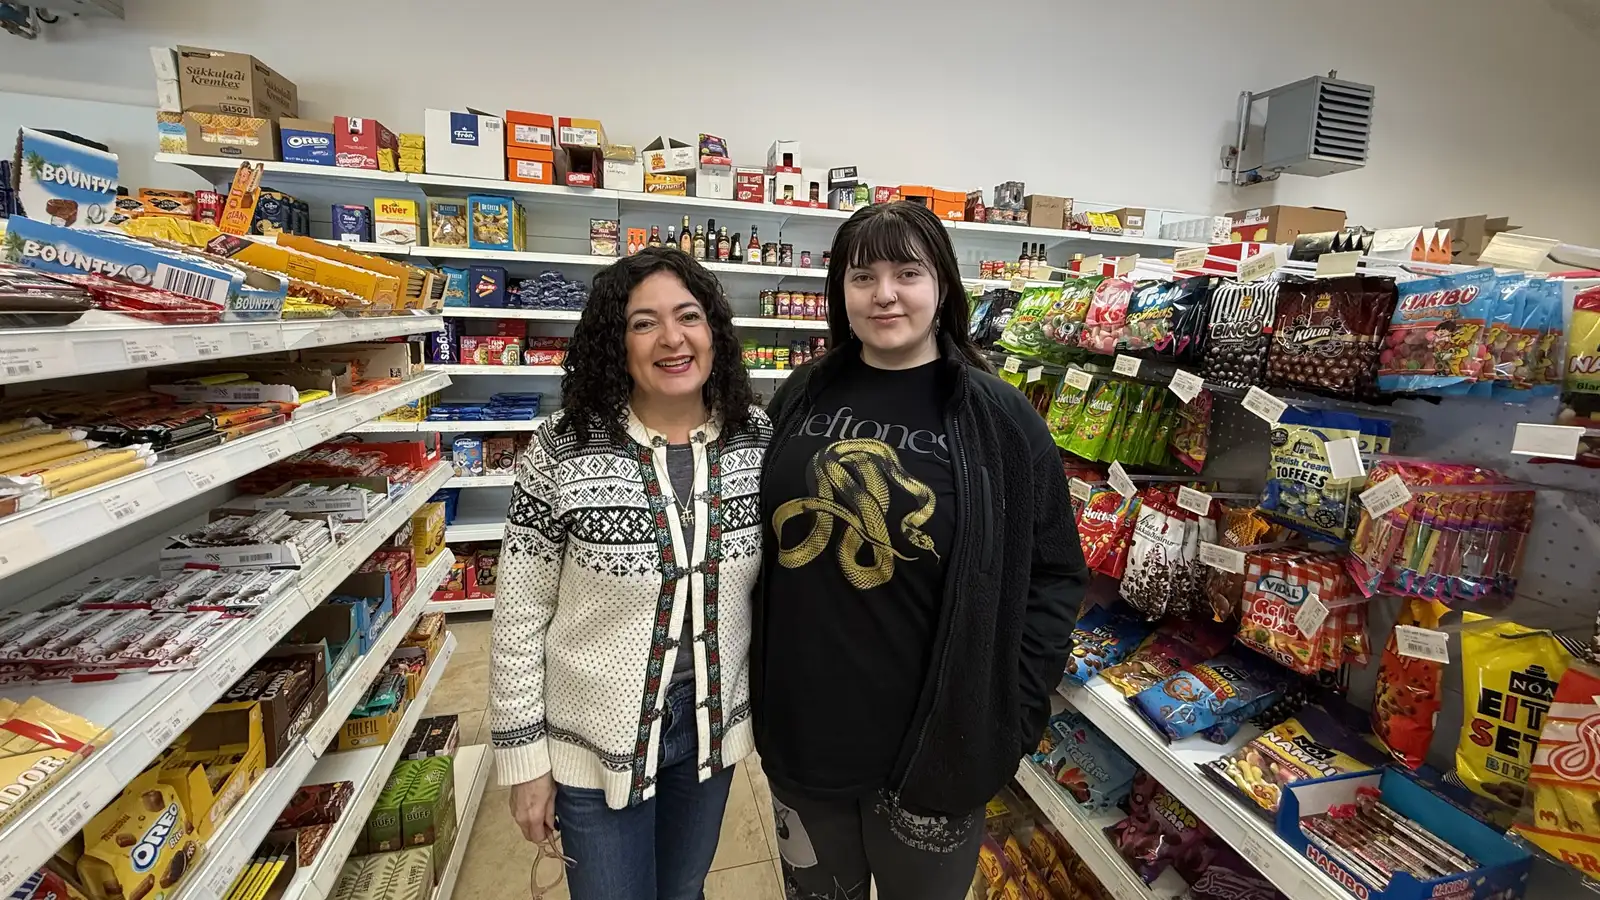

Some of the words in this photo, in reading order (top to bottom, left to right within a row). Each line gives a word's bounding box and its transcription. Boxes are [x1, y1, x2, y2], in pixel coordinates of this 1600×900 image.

[185, 65, 246, 82] Súkkulaði
[190, 74, 241, 90] Kremkex
[222, 106, 249, 115] 51502
[287, 135, 329, 149] OREO
[42, 162, 114, 194] BOUNTY
[226, 210, 249, 225] GIANT
[381, 203, 408, 215] River
[23, 240, 125, 279] BOUNTY
[234, 297, 272, 310] BOUNTY
[1400, 285, 1480, 313] HARIBO
[1293, 325, 1331, 343] KÚLUR
[1275, 455, 1300, 467] English
[1275, 465, 1329, 490] TOFFEES
[1265, 578, 1300, 601] VIDAL
[1512, 678, 1553, 699] NÓA
[1477, 687, 1551, 732] EIT
[347, 719, 380, 737] FULFIL
[1261, 731, 1340, 778] NAMMI
[371, 815, 396, 828] BUFF
[406, 810, 431, 822] BUFF
[130, 801, 180, 872] OREO
[1306, 843, 1370, 900] HARIBO
